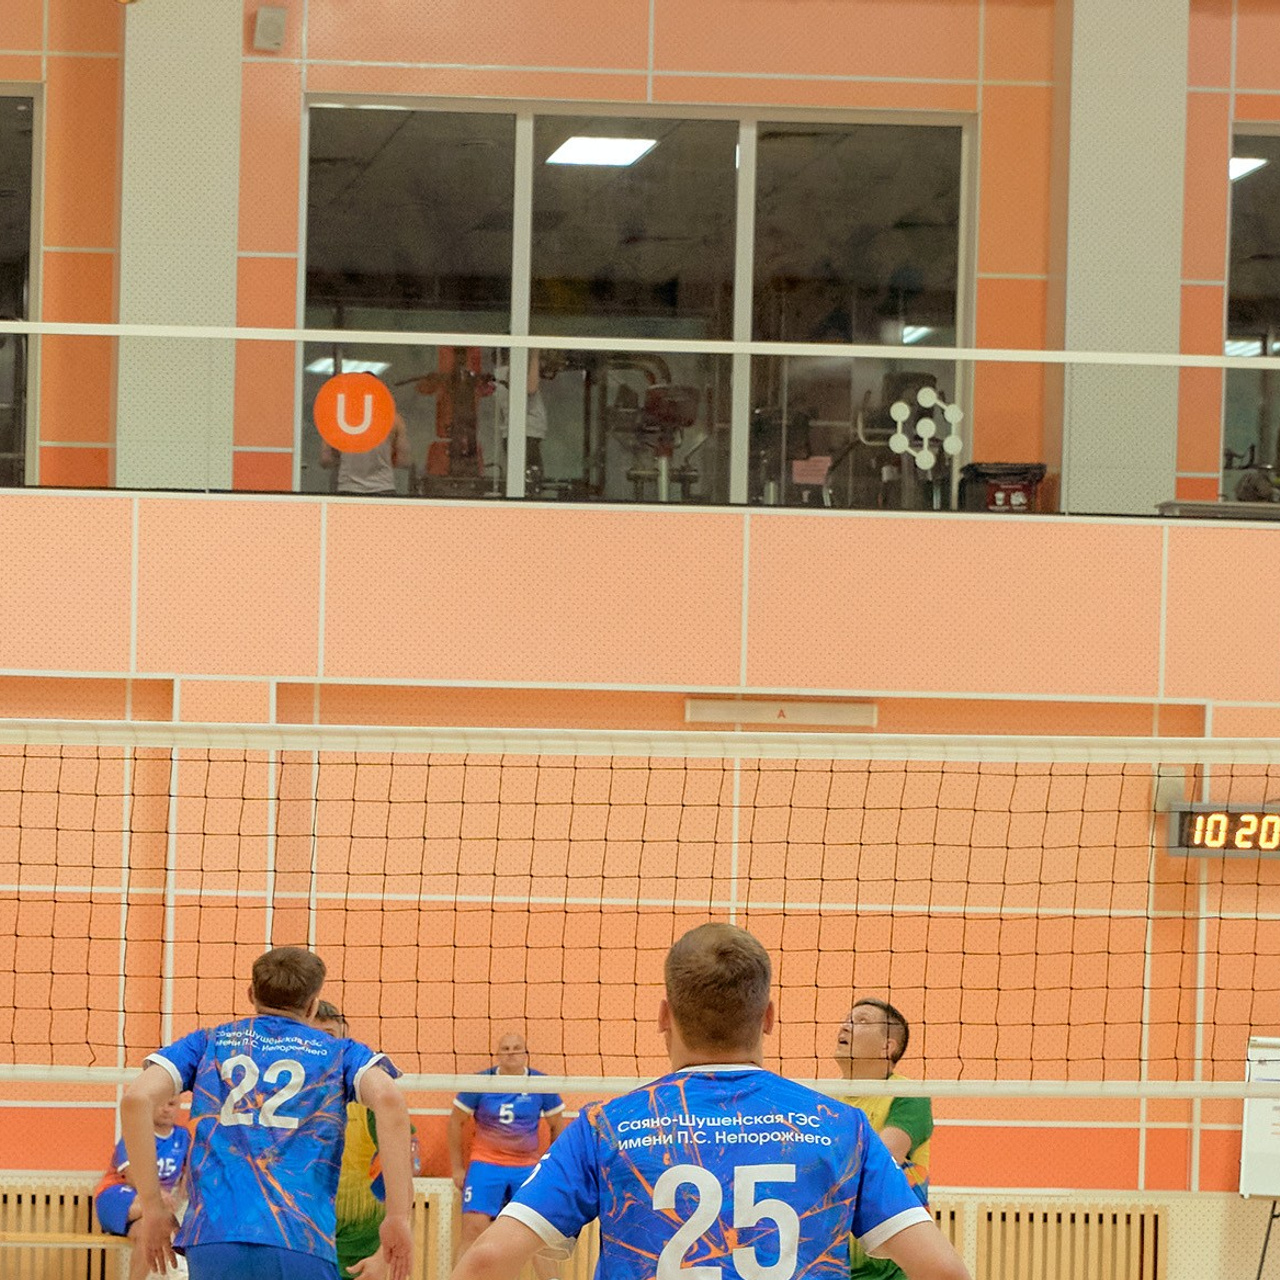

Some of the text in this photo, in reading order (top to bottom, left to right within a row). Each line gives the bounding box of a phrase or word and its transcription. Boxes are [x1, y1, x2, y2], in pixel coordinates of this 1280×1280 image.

[337, 393, 373, 435] U
[1193, 813, 1280, 849] 10 20
[220, 1054, 306, 1129] 22
[499, 1103, 515, 1124] 5
[617, 1112, 821, 1133] Саяно-Шушенская ГЭС
[618, 1131, 832, 1151] имени П.С. Непорожнего
[464, 1186, 473, 1202] 5
